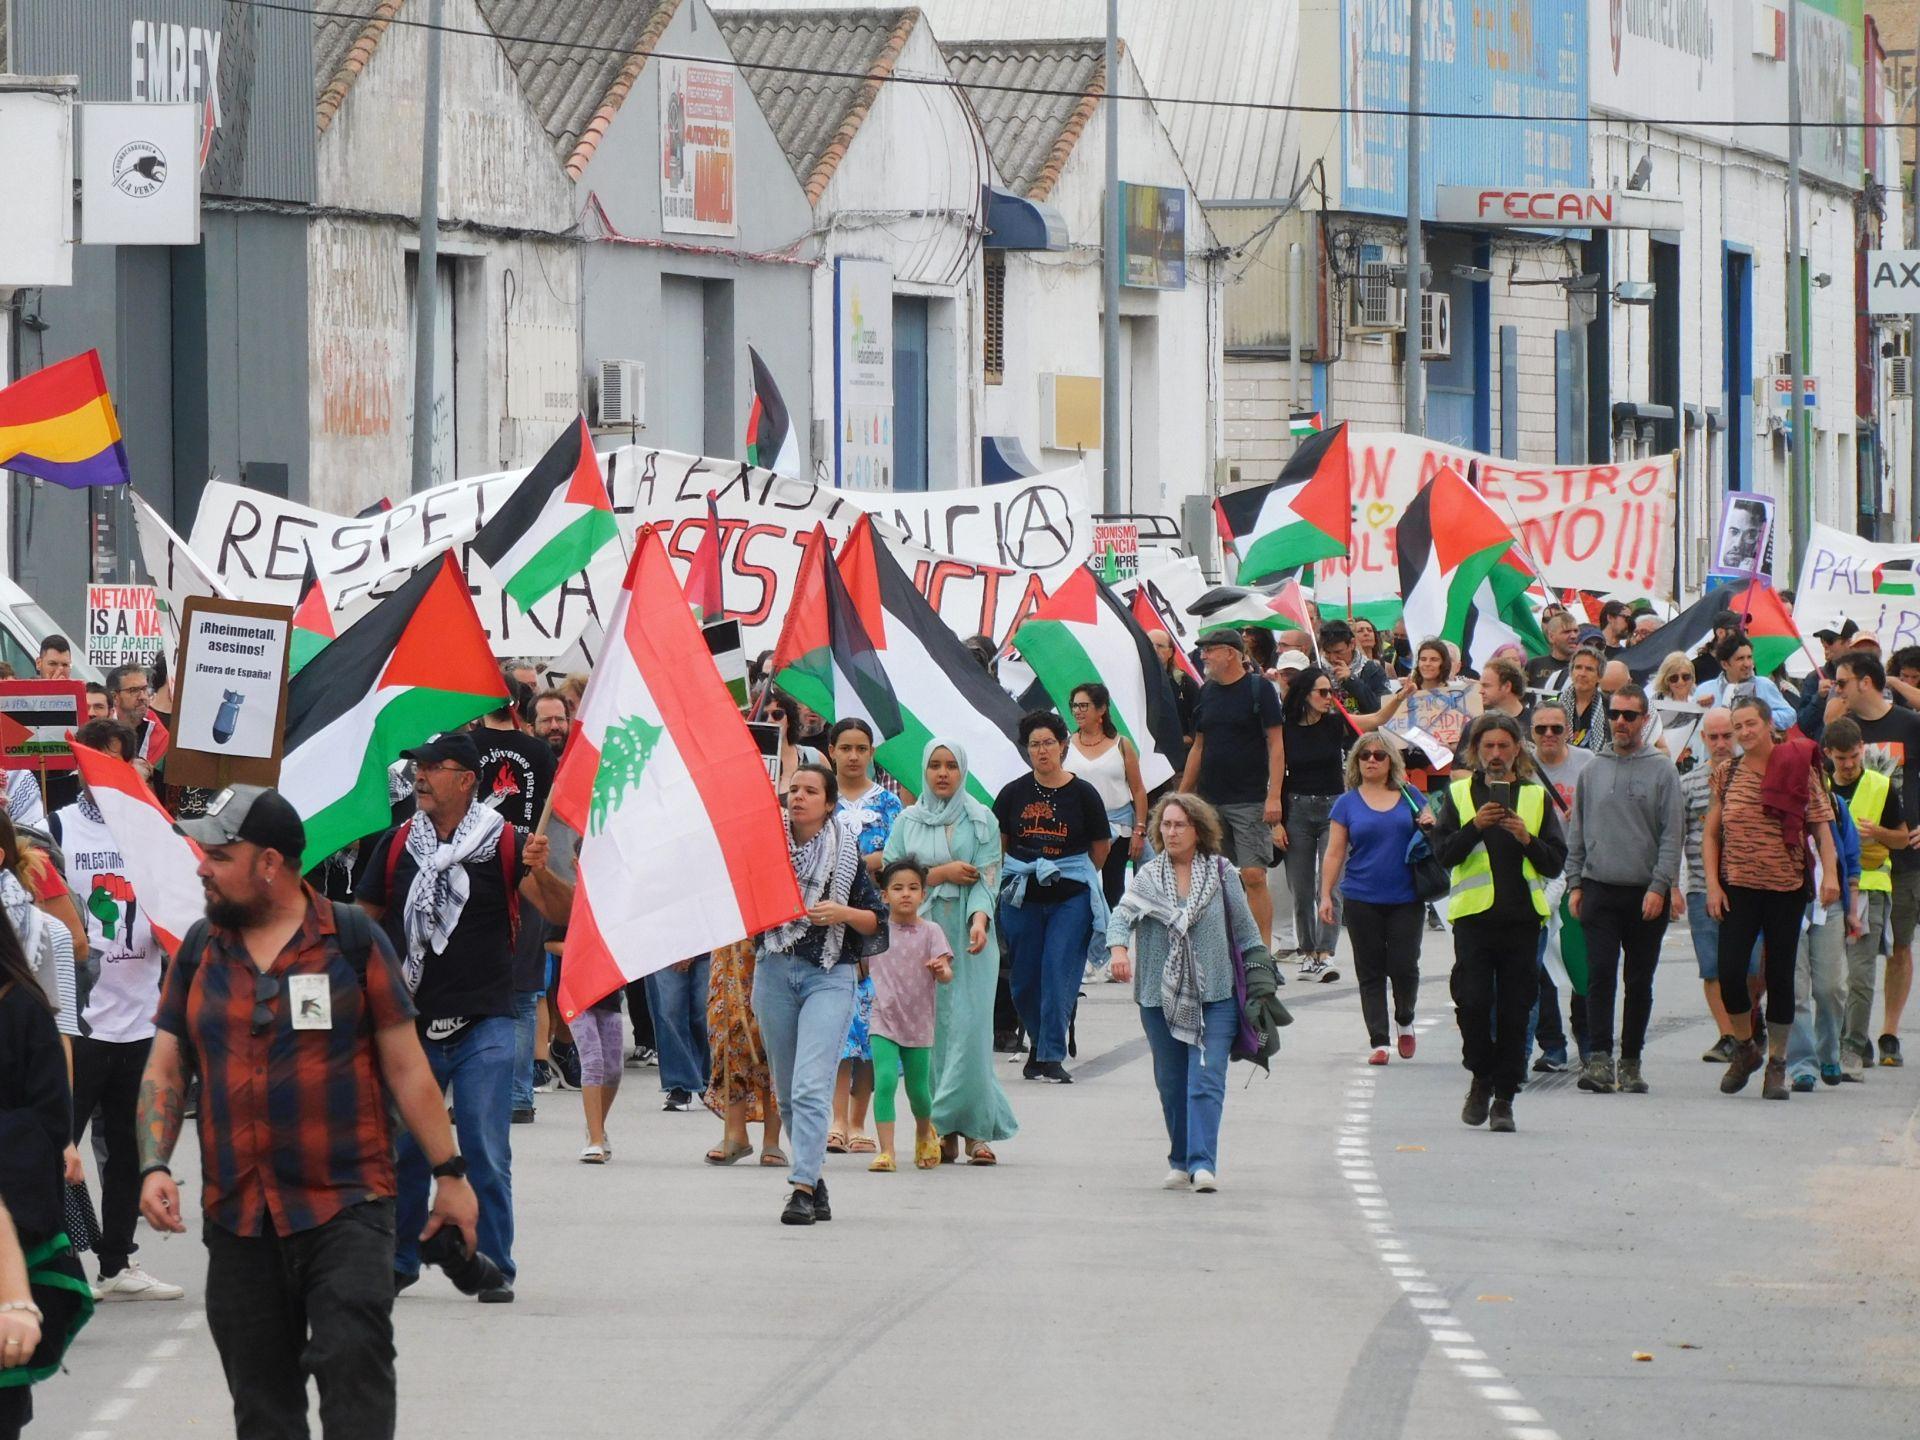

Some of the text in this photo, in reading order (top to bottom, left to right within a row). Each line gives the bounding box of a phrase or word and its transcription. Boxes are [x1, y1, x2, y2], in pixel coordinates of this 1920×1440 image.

[120, 179, 156, 195] LA VERA
[1478, 191, 1612, 221] FECAN
[1774, 378, 1816, 392] SER
[1417, 451, 1659, 504] NESTRO
[90, 608, 109, 636] IS
[115, 609, 129, 636] A
[200, 621, 276, 642] ¡Rheinmetall,
[89, 635, 118, 650] STOP
[208, 641, 265, 657] asesinos!
[89, 650, 117, 666] FREE
[195, 662, 272, 681] ¡Fuera de España!
[523, 771, 535, 799] para
[524, 802, 533, 821] ser
[432, 1016, 463, 1031] NIKE
